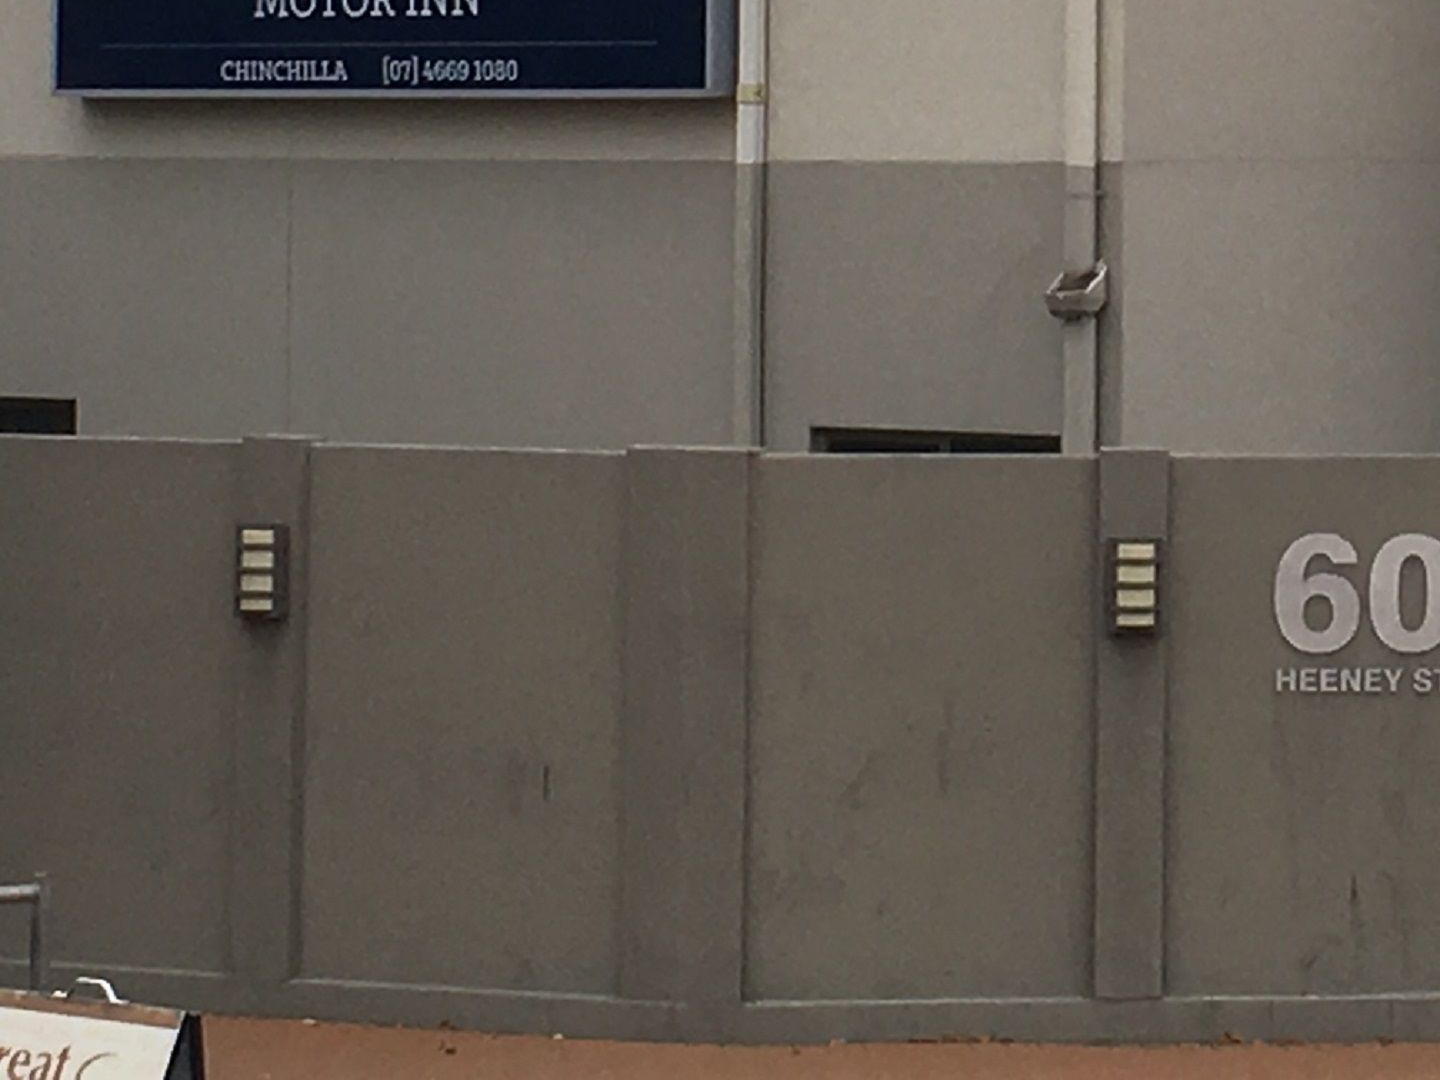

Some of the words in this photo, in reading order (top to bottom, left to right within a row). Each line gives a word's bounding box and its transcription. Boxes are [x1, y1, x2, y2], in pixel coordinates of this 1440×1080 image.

[220, 59, 348, 82] CHINCHILLA
[422, 59, 470, 81] 4669
[1276, 667, 1403, 692] HEENEY
